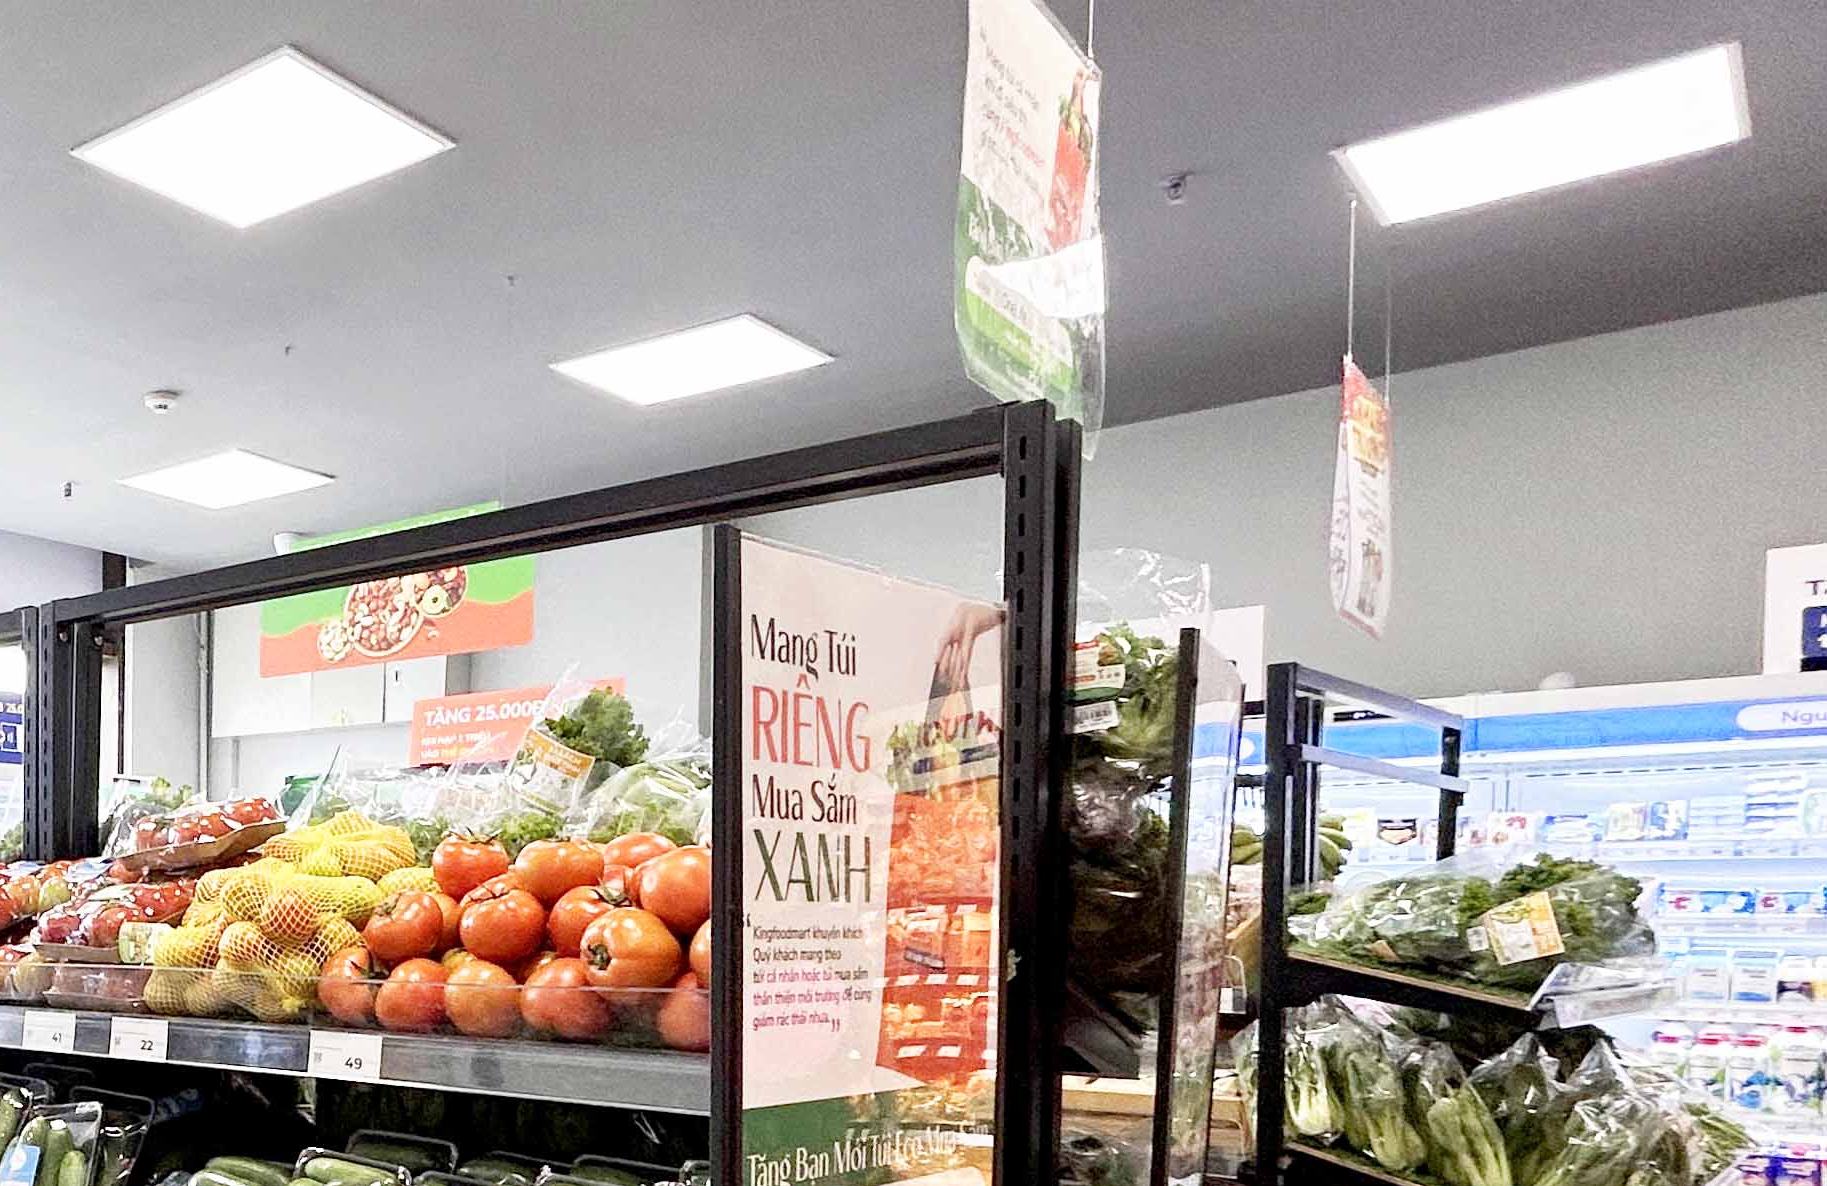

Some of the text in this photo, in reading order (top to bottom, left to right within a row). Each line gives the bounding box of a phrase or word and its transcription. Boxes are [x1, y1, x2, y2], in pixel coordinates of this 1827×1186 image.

[750, 614, 858, 681] Mang Túi
[751, 673, 871, 775] RIÊNG
[751, 769, 858, 825] Mua Sắm
[754, 828, 871, 904] XANH
[140, 1040, 153, 1051] 22
[345, 1057, 363, 1070] 49
[795, 1147, 829, 1186] Bạn
